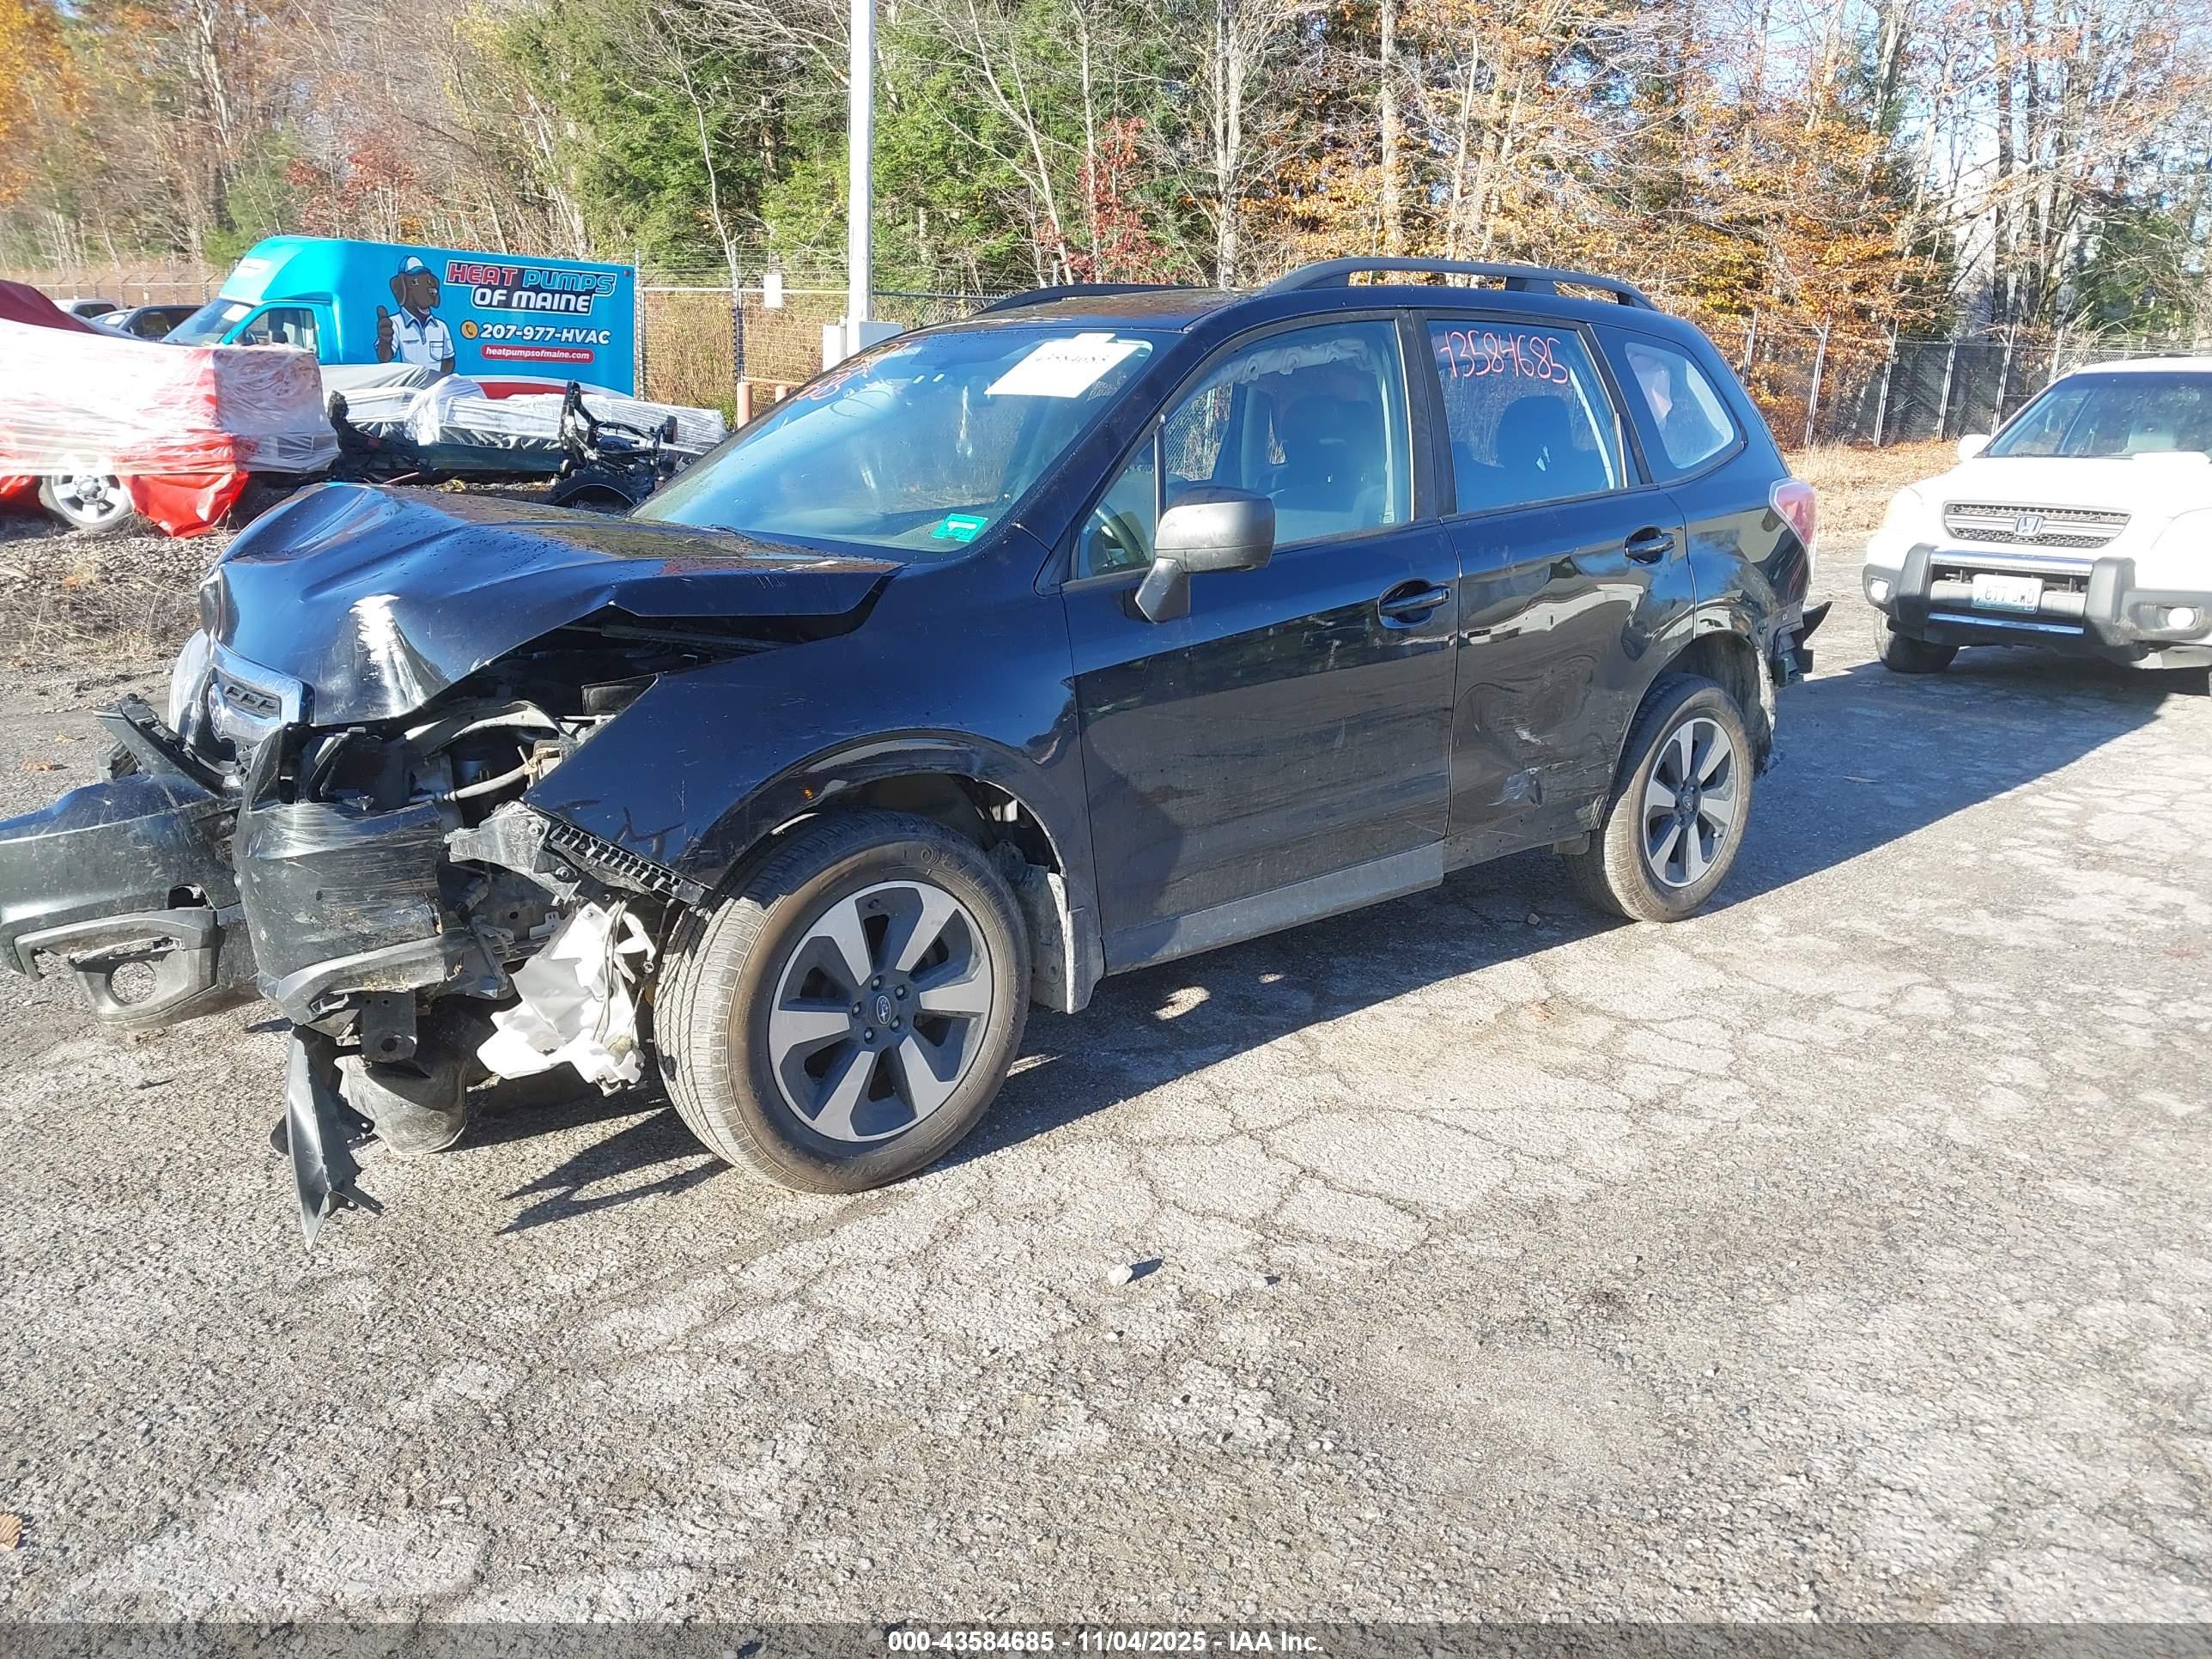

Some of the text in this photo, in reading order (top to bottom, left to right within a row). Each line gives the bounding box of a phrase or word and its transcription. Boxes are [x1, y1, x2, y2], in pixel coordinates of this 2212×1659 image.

[448, 263, 616, 293] HEAT PUMPS
[474, 288, 591, 313] OF MAINE
[480, 323, 611, 344] 207-977-HVAC
[485, 346, 590, 360] heatpumpsofmaine.com
